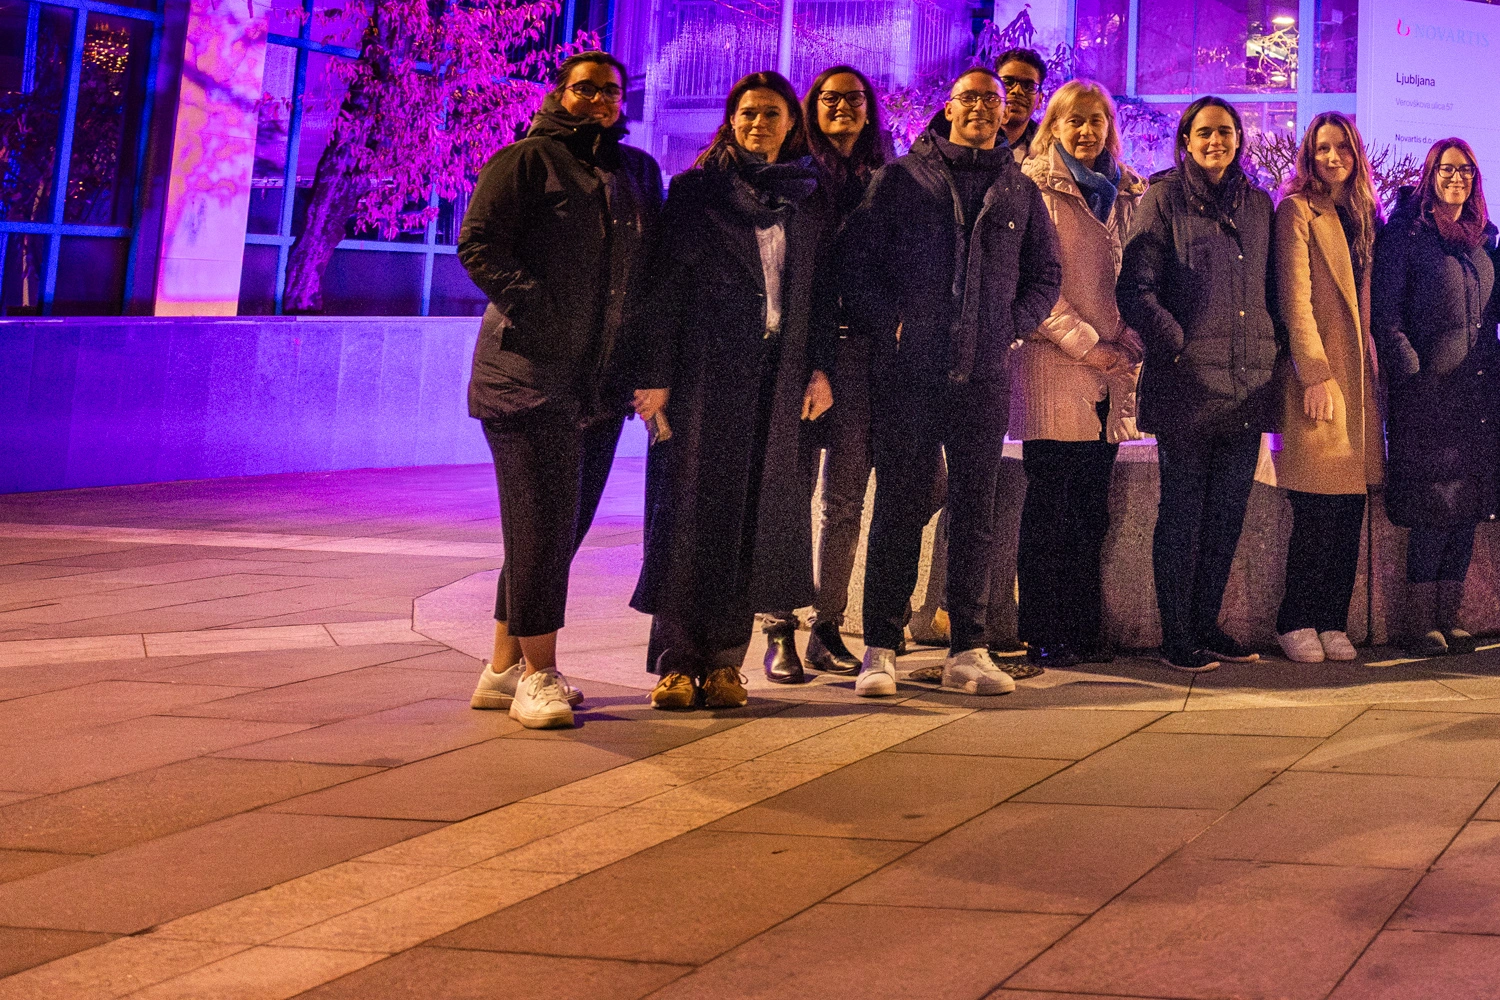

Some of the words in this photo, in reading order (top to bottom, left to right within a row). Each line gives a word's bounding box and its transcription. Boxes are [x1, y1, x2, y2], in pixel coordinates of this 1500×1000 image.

[1415, 23, 1489, 47] NOVARTIS
[1396, 72, 1435, 87] Ljubljana
[1395, 134, 1421, 143] Novartis
